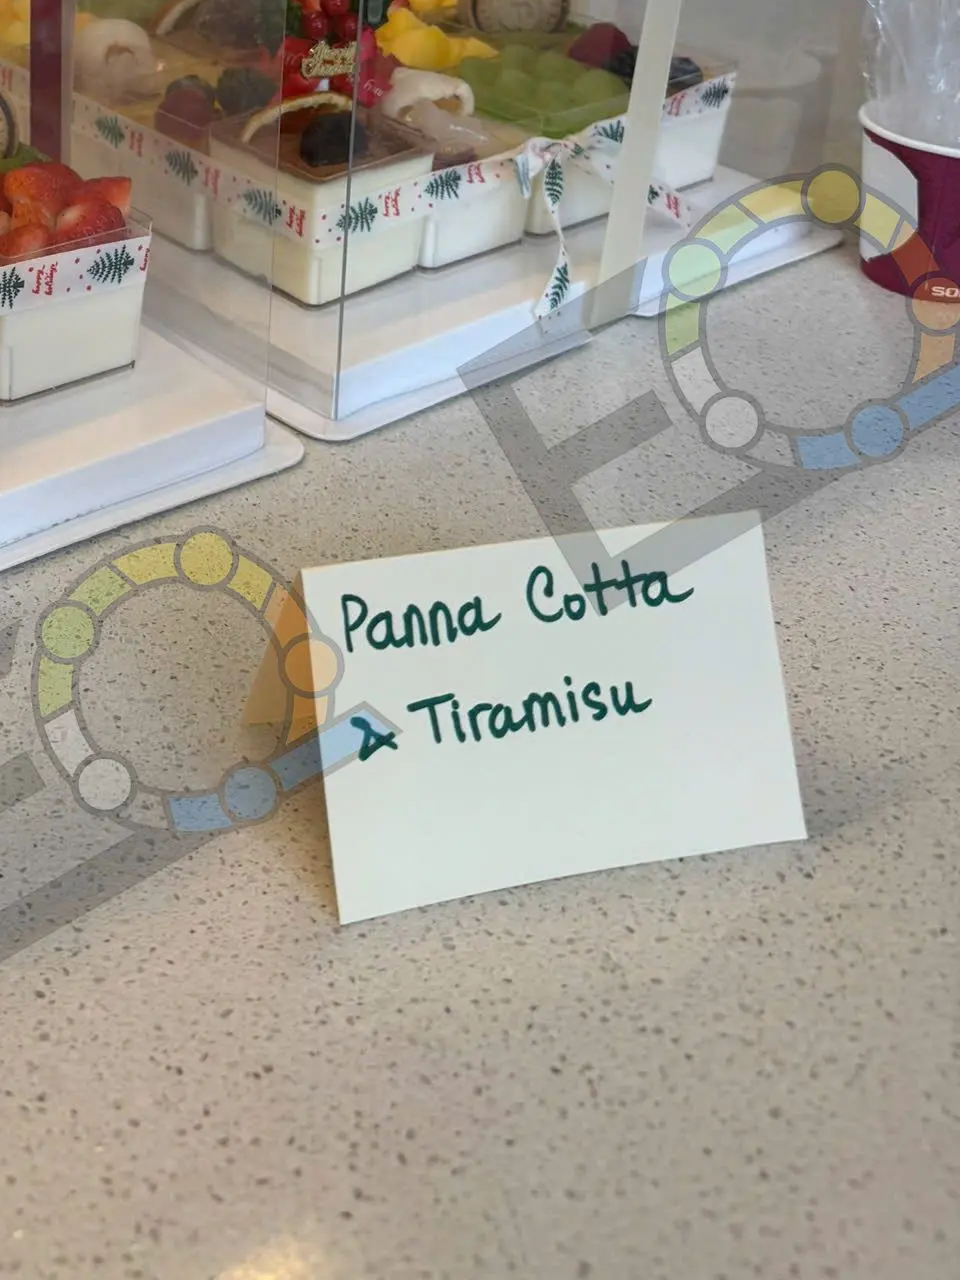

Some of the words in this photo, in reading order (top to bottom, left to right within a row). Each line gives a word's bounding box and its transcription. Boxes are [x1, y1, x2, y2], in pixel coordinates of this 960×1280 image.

[931, 285, 960, 298] SO
[341, 593, 502, 653] Panna
[526, 559, 695, 622] Cotta
[406, 675, 653, 744] Tiramisu
